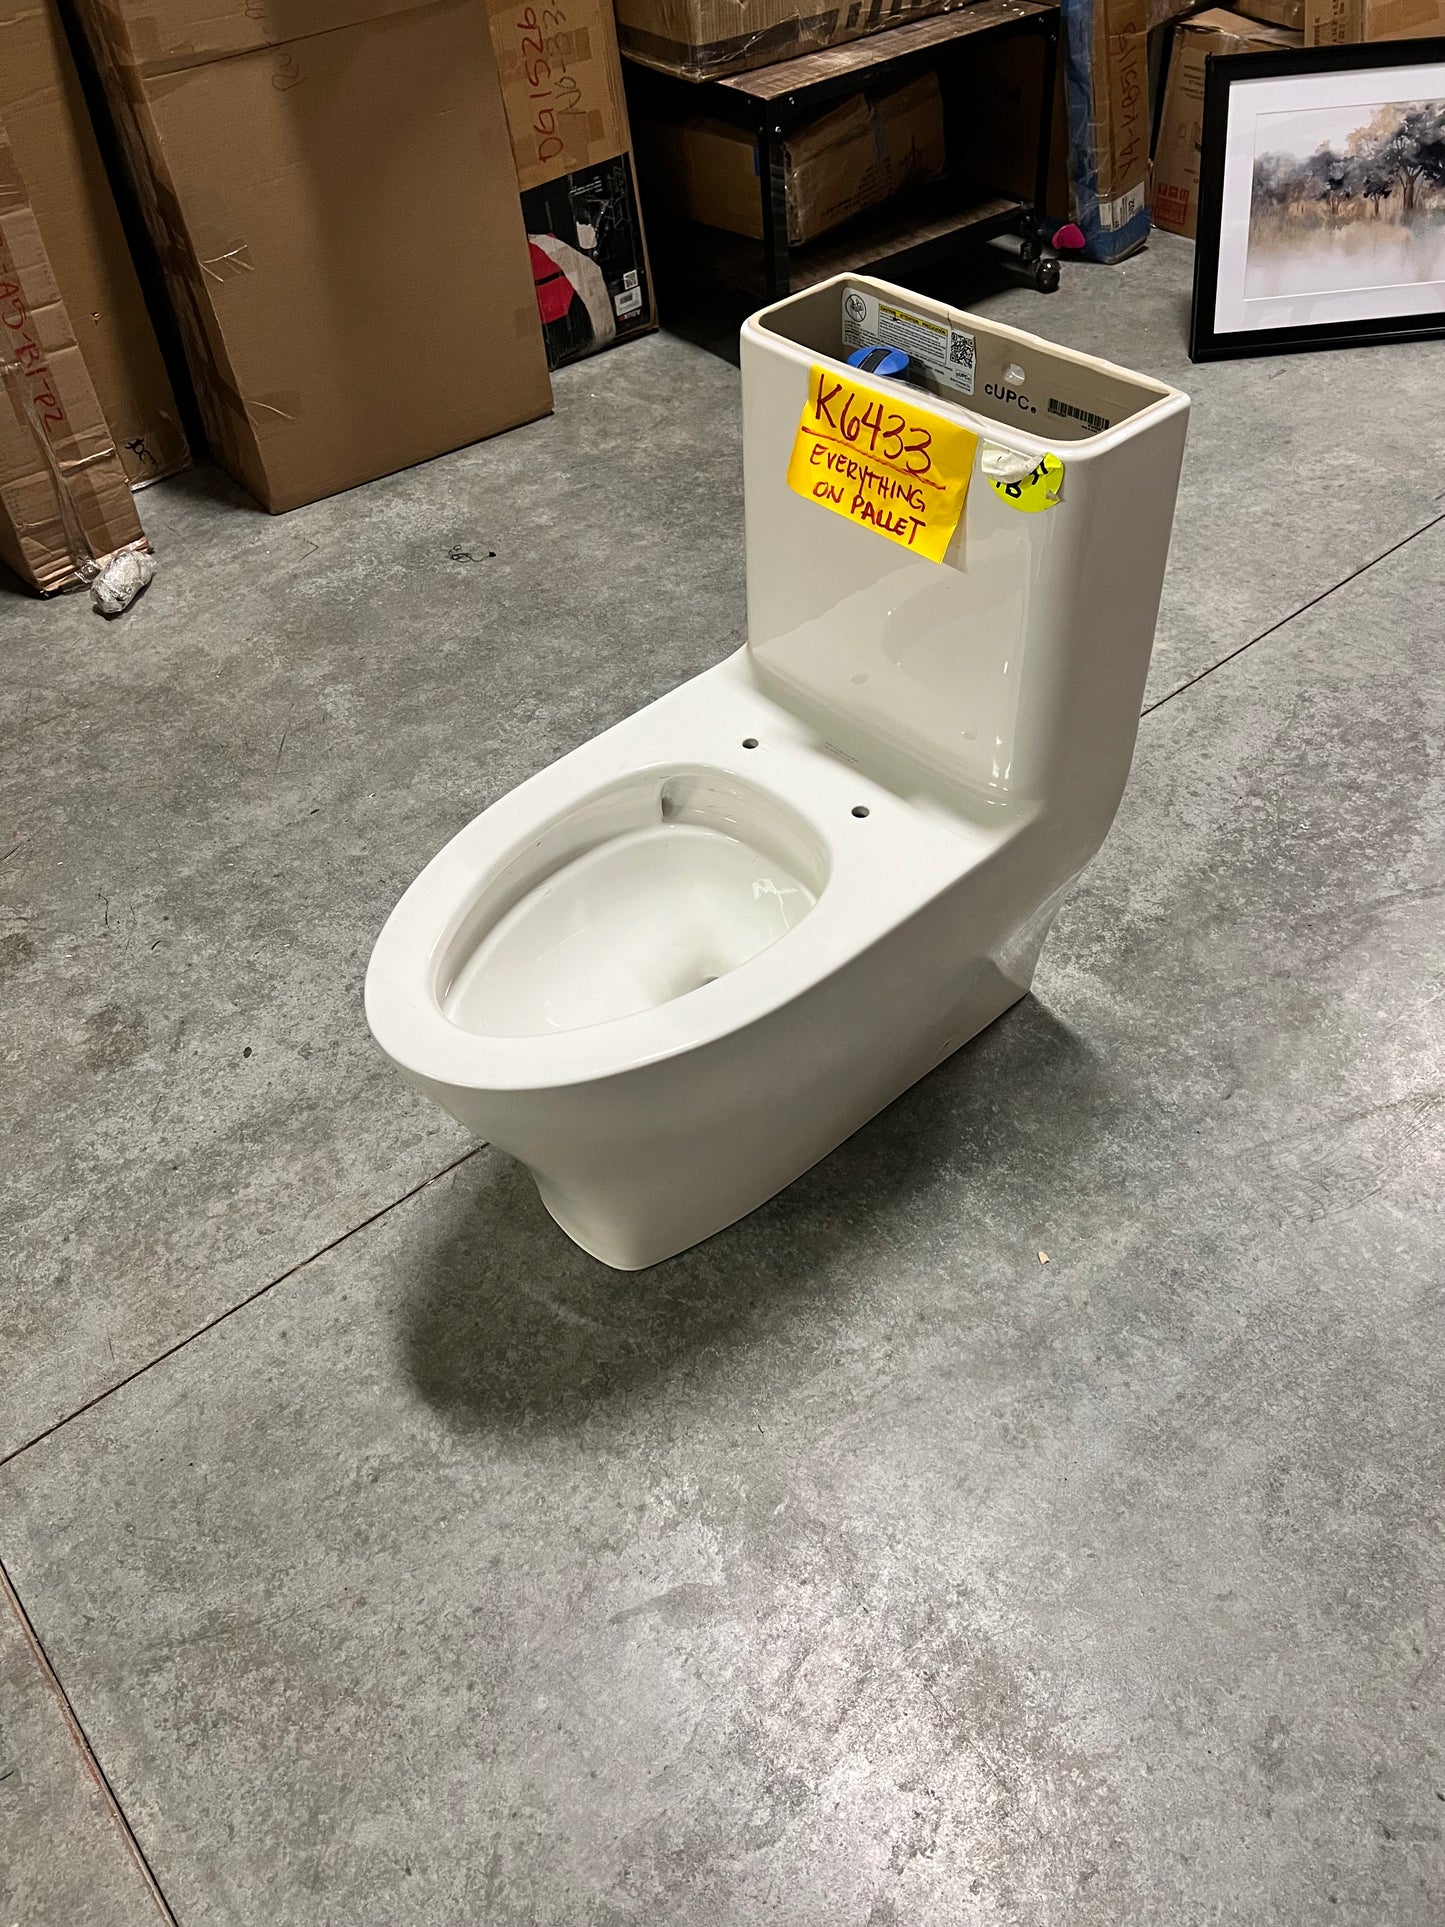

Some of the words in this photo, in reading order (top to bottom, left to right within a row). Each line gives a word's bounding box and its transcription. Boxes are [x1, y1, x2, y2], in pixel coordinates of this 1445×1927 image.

[815, 373, 932, 473] K6433
[809, 443, 926, 512] EVERYTHING
[812, 481, 844, 504] ON
[850, 494, 927, 545] PALLET
